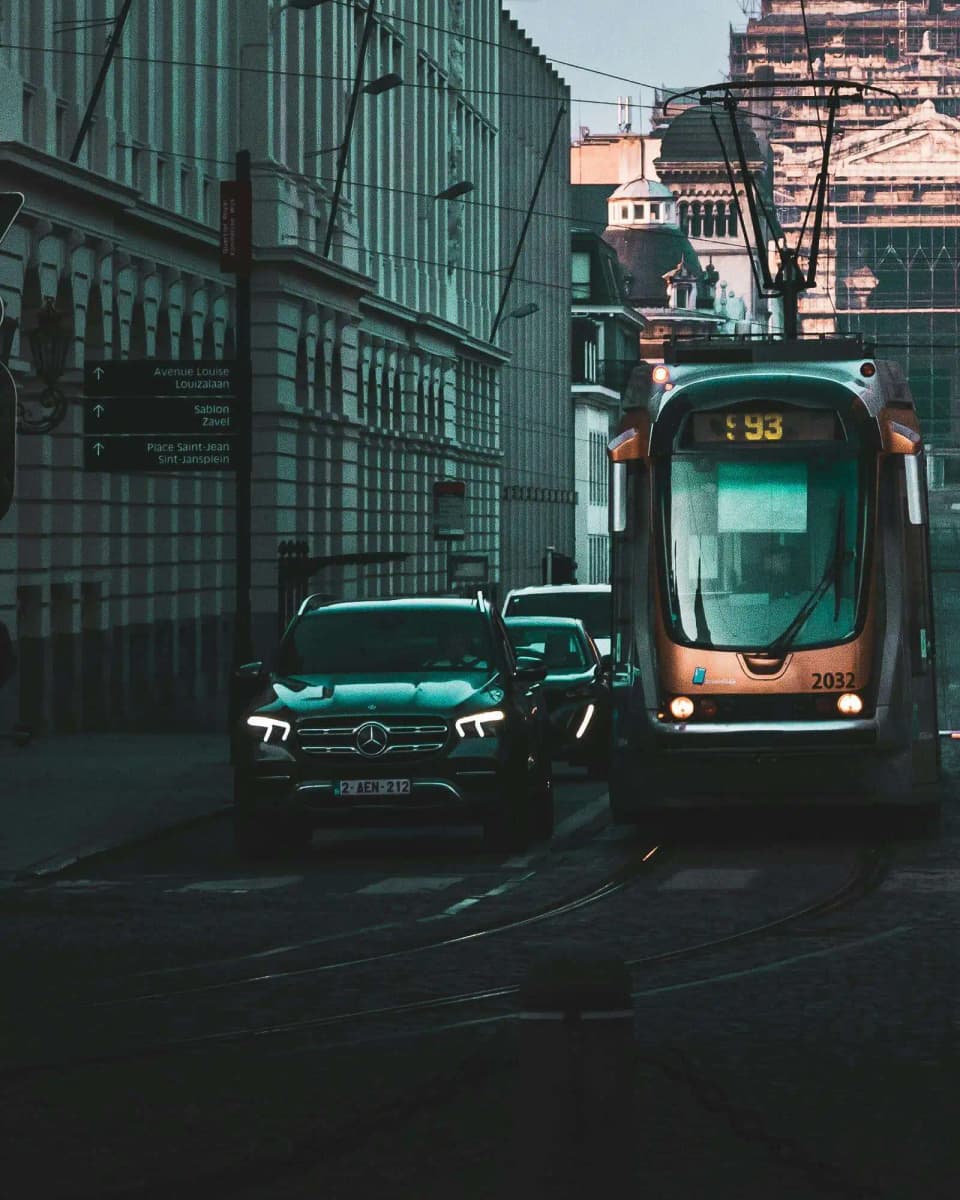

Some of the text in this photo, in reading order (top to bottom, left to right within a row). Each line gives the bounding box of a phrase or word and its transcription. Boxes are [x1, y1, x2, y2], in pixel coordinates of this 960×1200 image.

[153, 367, 230, 377] Avenue Louise
[175, 379, 230, 389] Louizalaan
[194, 404, 230, 414] Sablon
[202, 417, 230, 426] Zavel
[744, 413, 784, 441] 93
[147, 443, 230, 452] Place Saint-Jean
[158, 455, 230, 465] Sint-Jansplein
[811, 671, 855, 689] 2032
[341, 780, 409, 793] 2-AEN-212
